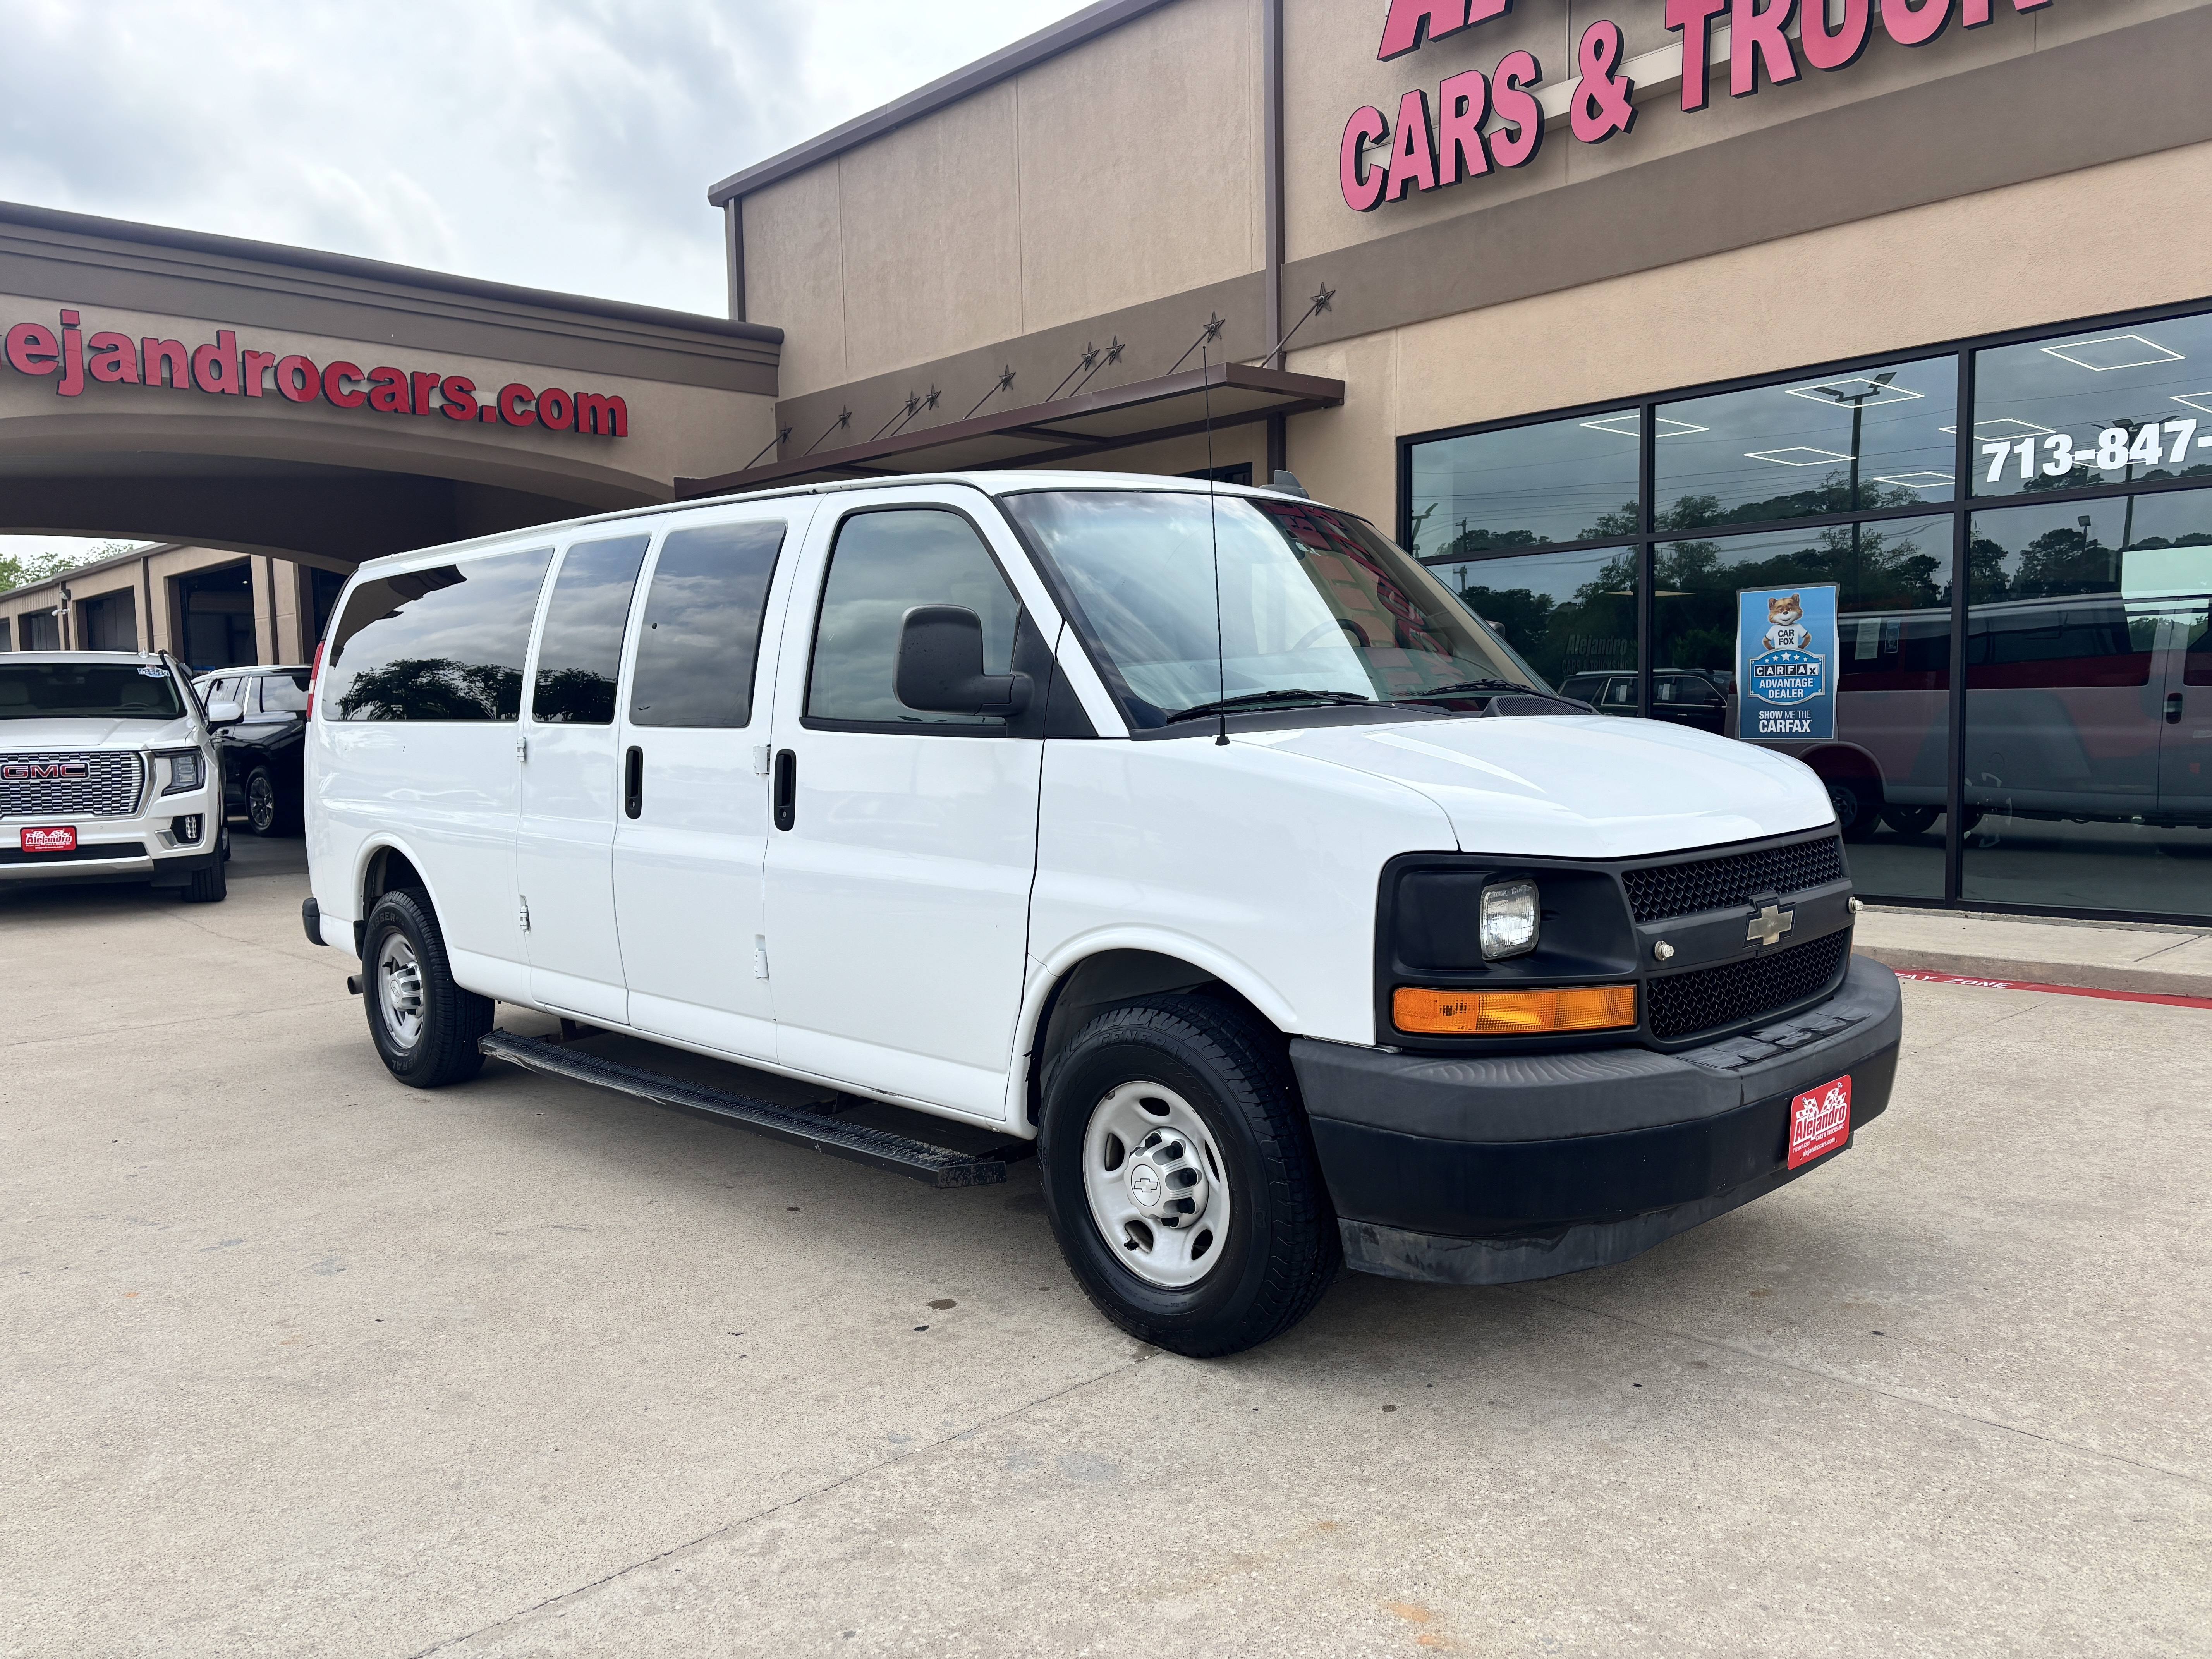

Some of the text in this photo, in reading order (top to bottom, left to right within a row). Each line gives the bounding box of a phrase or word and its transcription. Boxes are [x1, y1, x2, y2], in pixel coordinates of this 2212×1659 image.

[1341, 50, 1545, 211] CARS
[1570, 19, 1638, 144] &
[1665, 0, 2053, 113] TRU
[4, 309, 629, 438] ejandrocars.com
[1778, 629, 1795, 637] CAR
[1566, 634, 1628, 657] Alejandro
[1778, 637, 1795, 646] FOX
[1755, 665, 1819, 677] CARFAX
[1759, 678, 1814, 688] ADVANTAGE
[1768, 689, 1804, 698] DEALER
[1759, 710, 1811, 719] SHOW ME THE
[1759, 719, 1812, 733] CARFAX
[3, 764, 86, 779] GMC
[26, 835, 72, 844] Alejandro
[1944, 978, 2014, 988] ZONE
[1794, 1104, 1846, 1143] Alejandro
